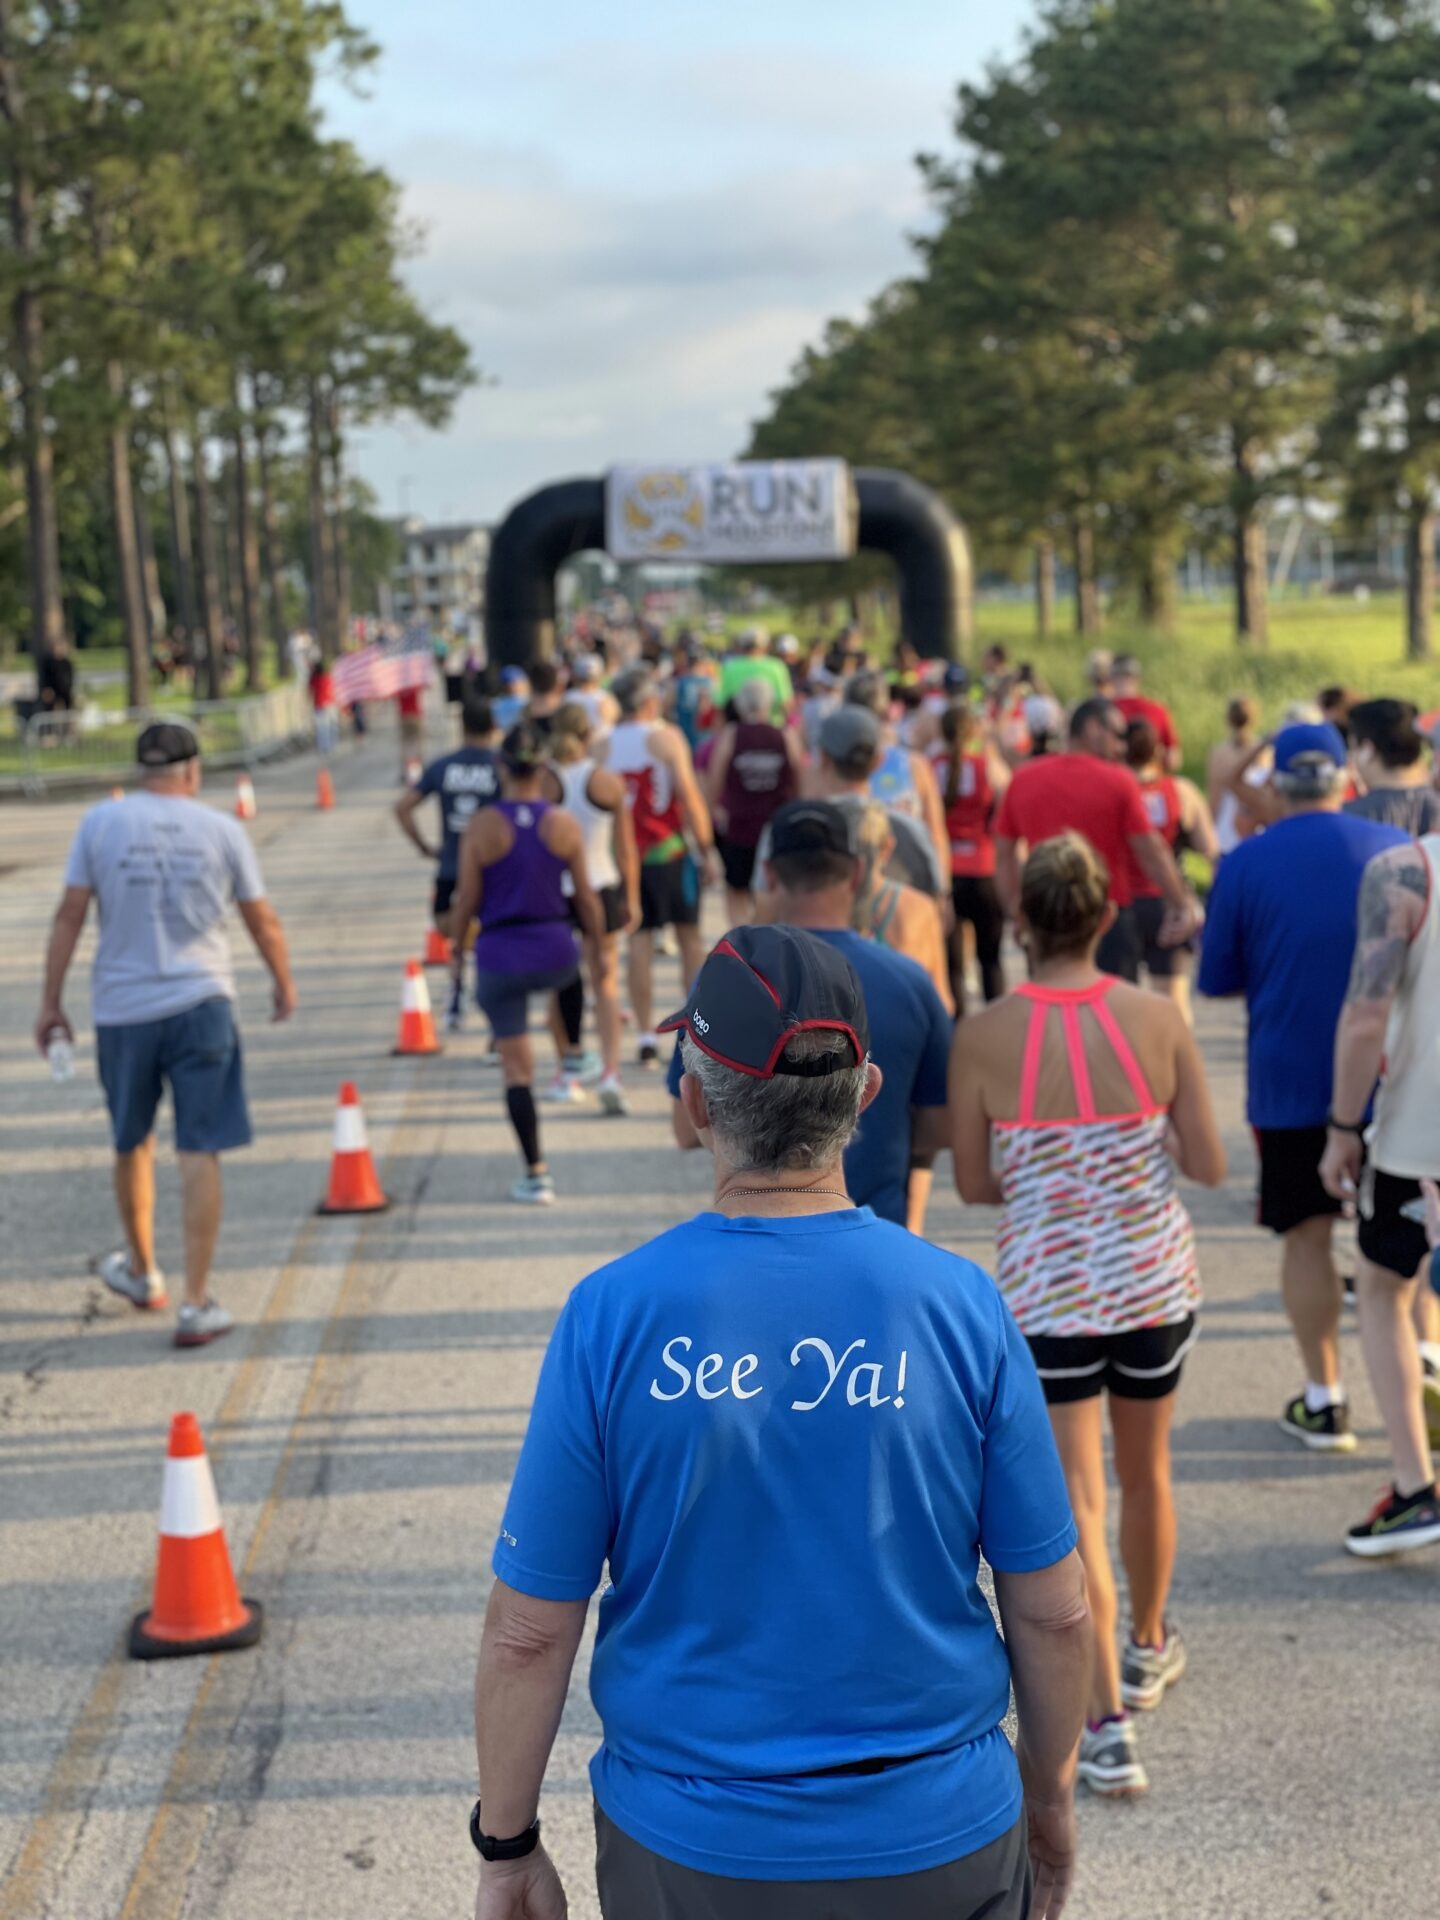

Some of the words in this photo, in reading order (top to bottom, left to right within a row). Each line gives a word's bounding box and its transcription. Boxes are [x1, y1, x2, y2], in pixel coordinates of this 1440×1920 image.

[711, 473, 822, 515] RUN
[649, 1335, 763, 1401] See
[790, 1337, 907, 1411] Ya!
